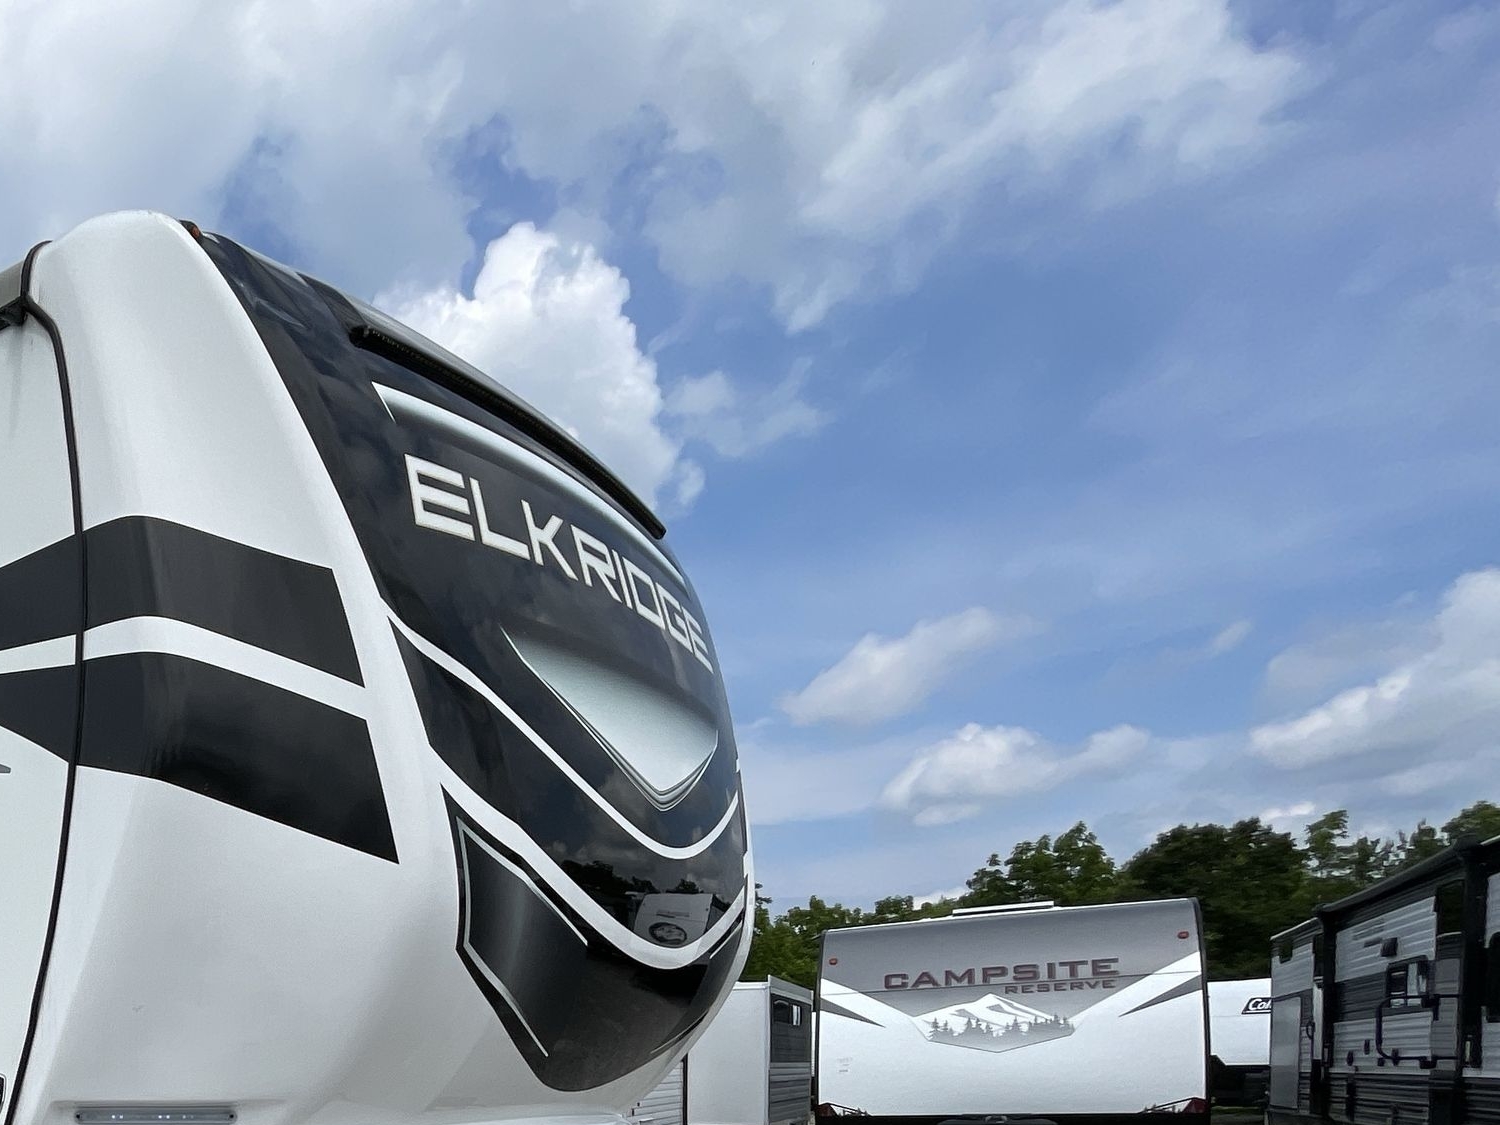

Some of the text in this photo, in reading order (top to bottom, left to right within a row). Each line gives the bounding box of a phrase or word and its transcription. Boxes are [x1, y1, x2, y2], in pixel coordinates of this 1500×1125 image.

[404, 454, 714, 674] ELKRIDGE
[884, 957, 1120, 990] CAMPSITE
[1004, 979, 1117, 995] RESERVE
